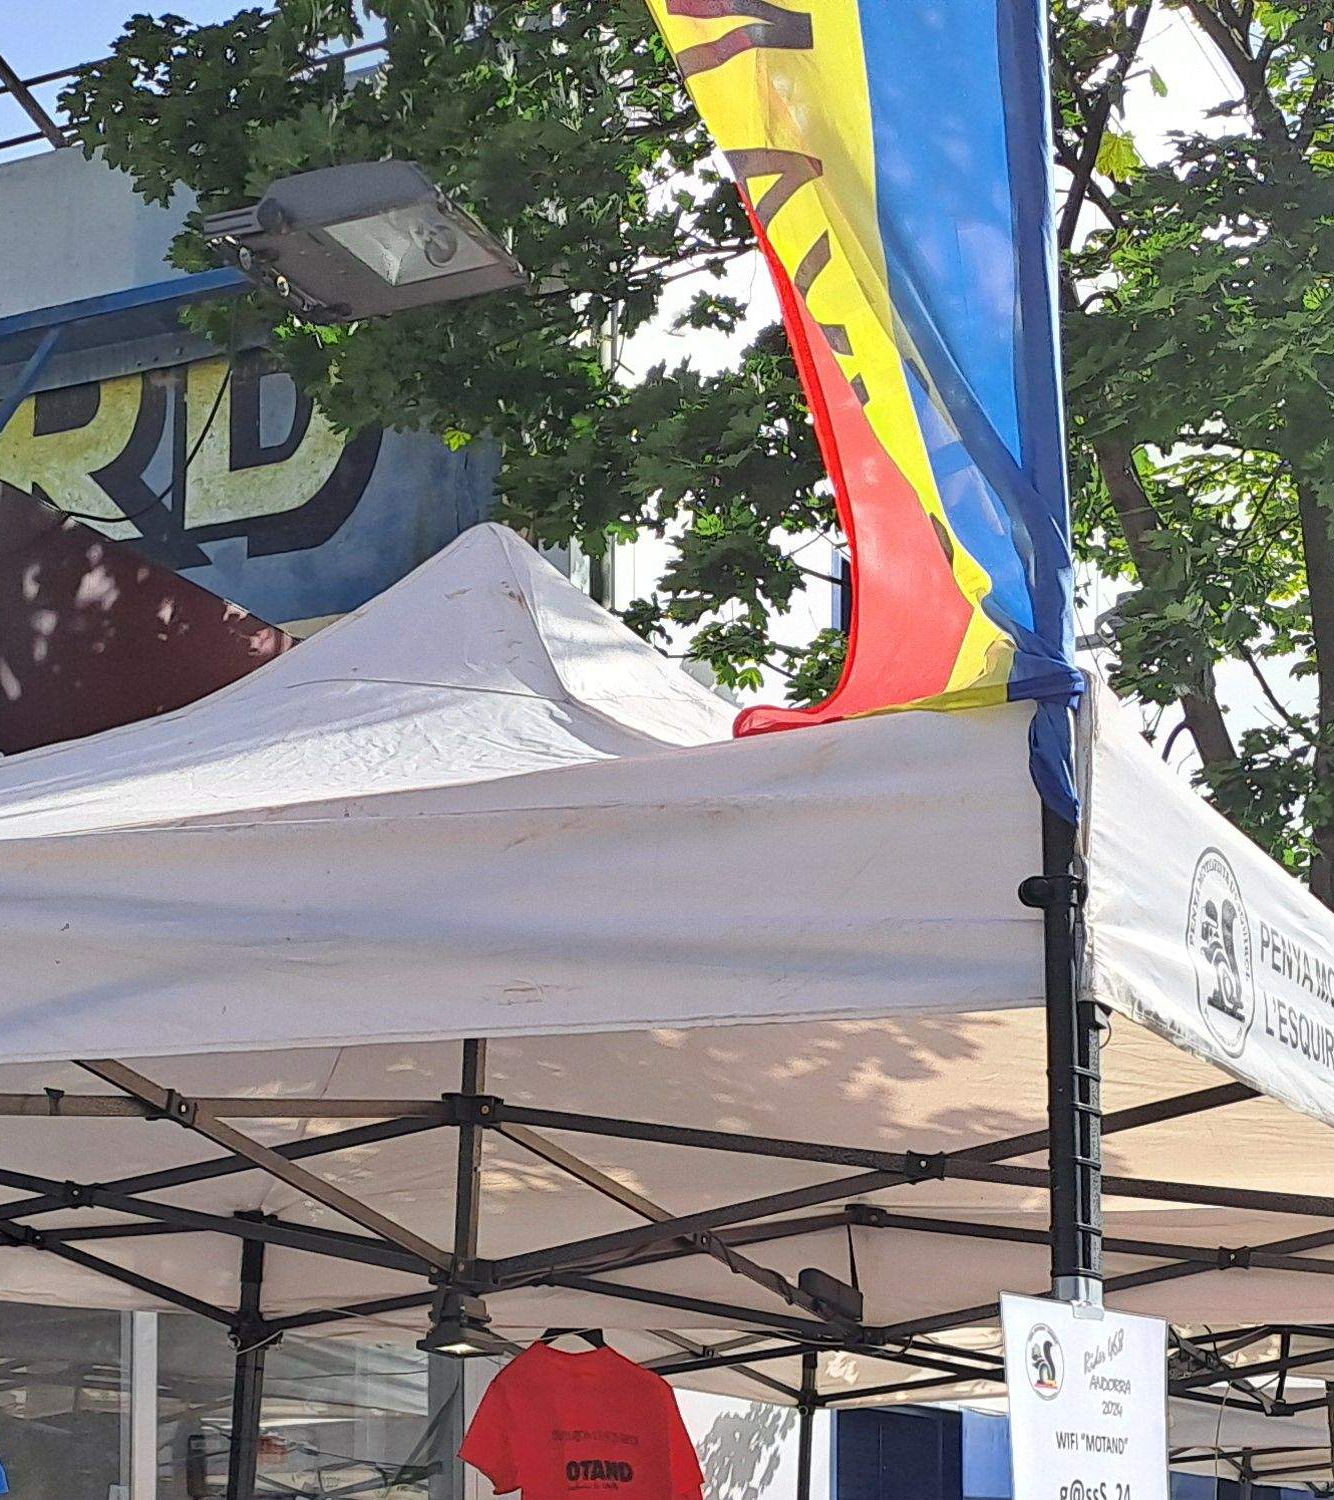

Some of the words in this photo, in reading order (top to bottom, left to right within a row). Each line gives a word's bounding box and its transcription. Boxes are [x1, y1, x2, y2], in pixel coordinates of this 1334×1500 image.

[1259, 920, 1314, 994] PENYA
[1089, 1375, 1132, 1395] ANDORRA
[1101, 1400, 1124, 1417] 2024
[1055, 1431, 1079, 1450] WIFI
